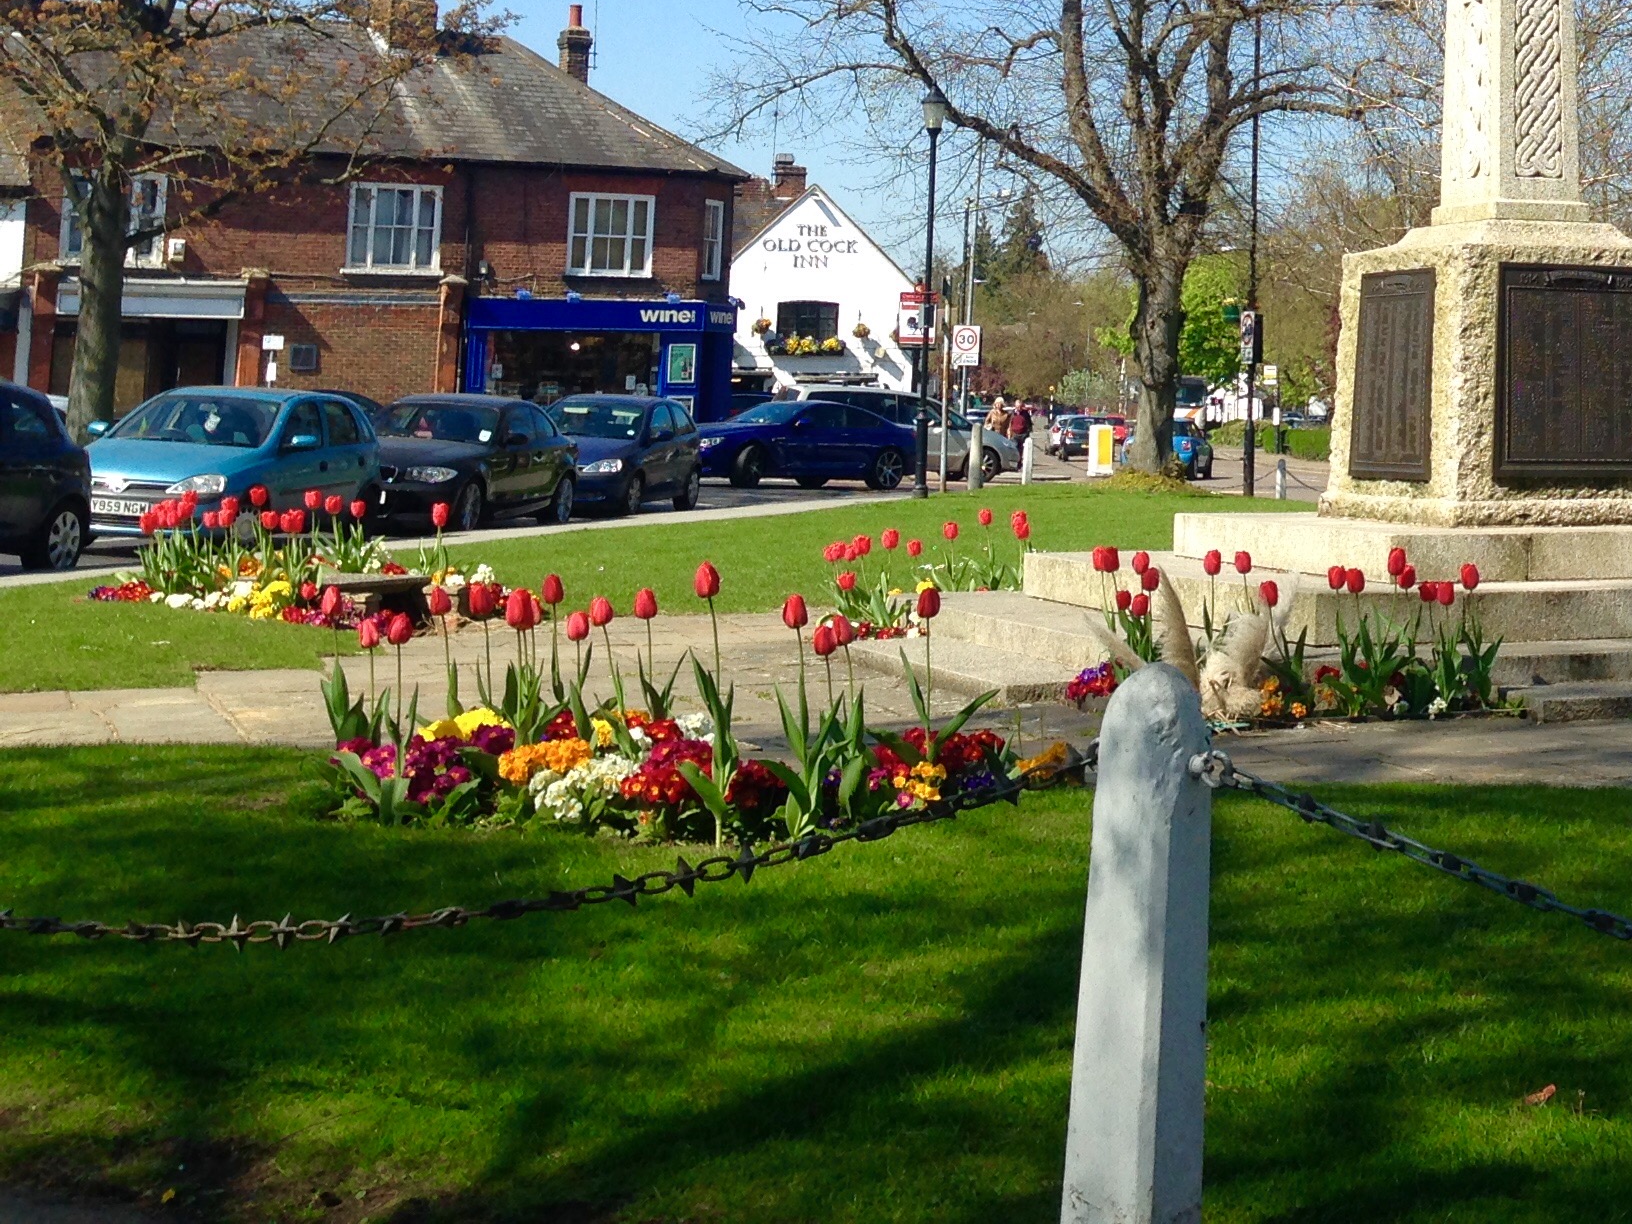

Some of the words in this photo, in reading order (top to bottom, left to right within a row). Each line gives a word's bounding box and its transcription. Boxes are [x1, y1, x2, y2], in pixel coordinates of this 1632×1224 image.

[796, 224, 828, 237] THE
[762, 238, 802, 252] OLD
[807, 239, 859, 254] COCK
[793, 254, 829, 269] INN
[639, 309, 692, 324] wine
[709, 310, 734, 325] wine
[958, 334, 975, 345] 30
[92, 499, 121, 513] Y959
